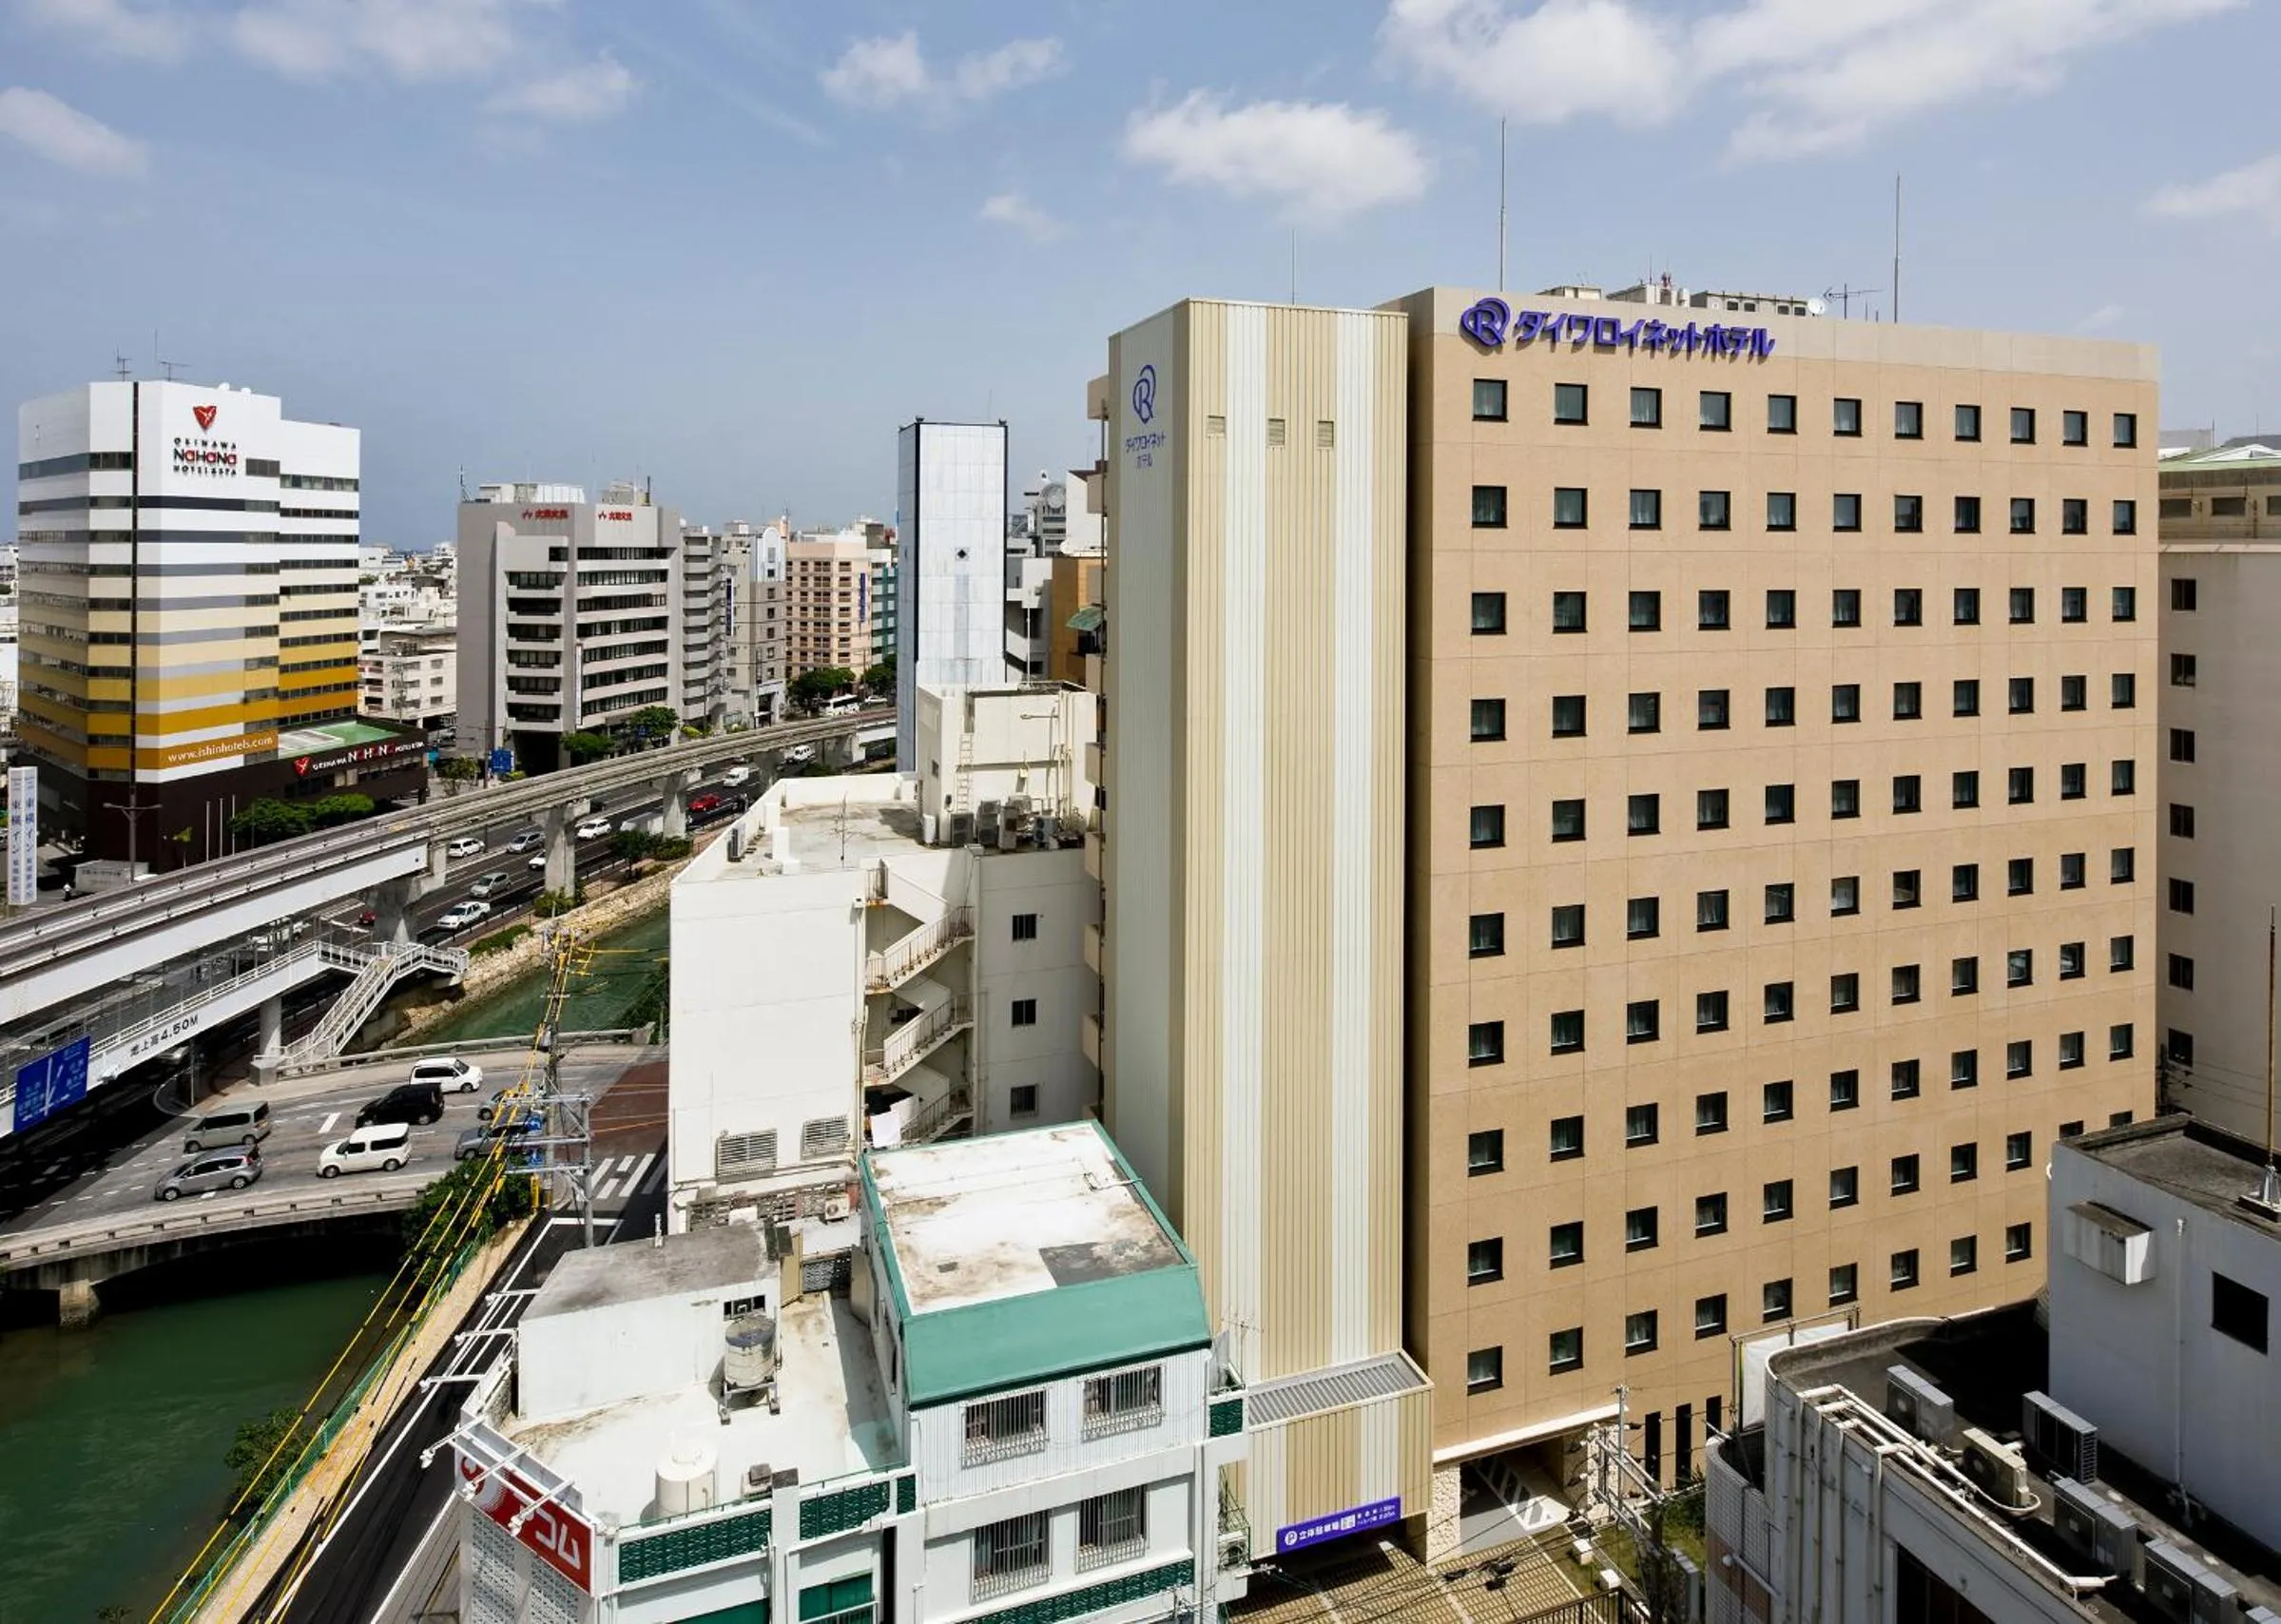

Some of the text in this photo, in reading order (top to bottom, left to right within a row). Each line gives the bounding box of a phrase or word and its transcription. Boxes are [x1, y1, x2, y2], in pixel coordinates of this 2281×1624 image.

[1516, 310, 1775, 358] ダイワロイネットホテル
[173, 436, 237, 450] OKINAWA
[167, 736, 273, 763] www.ishinhotels.com
